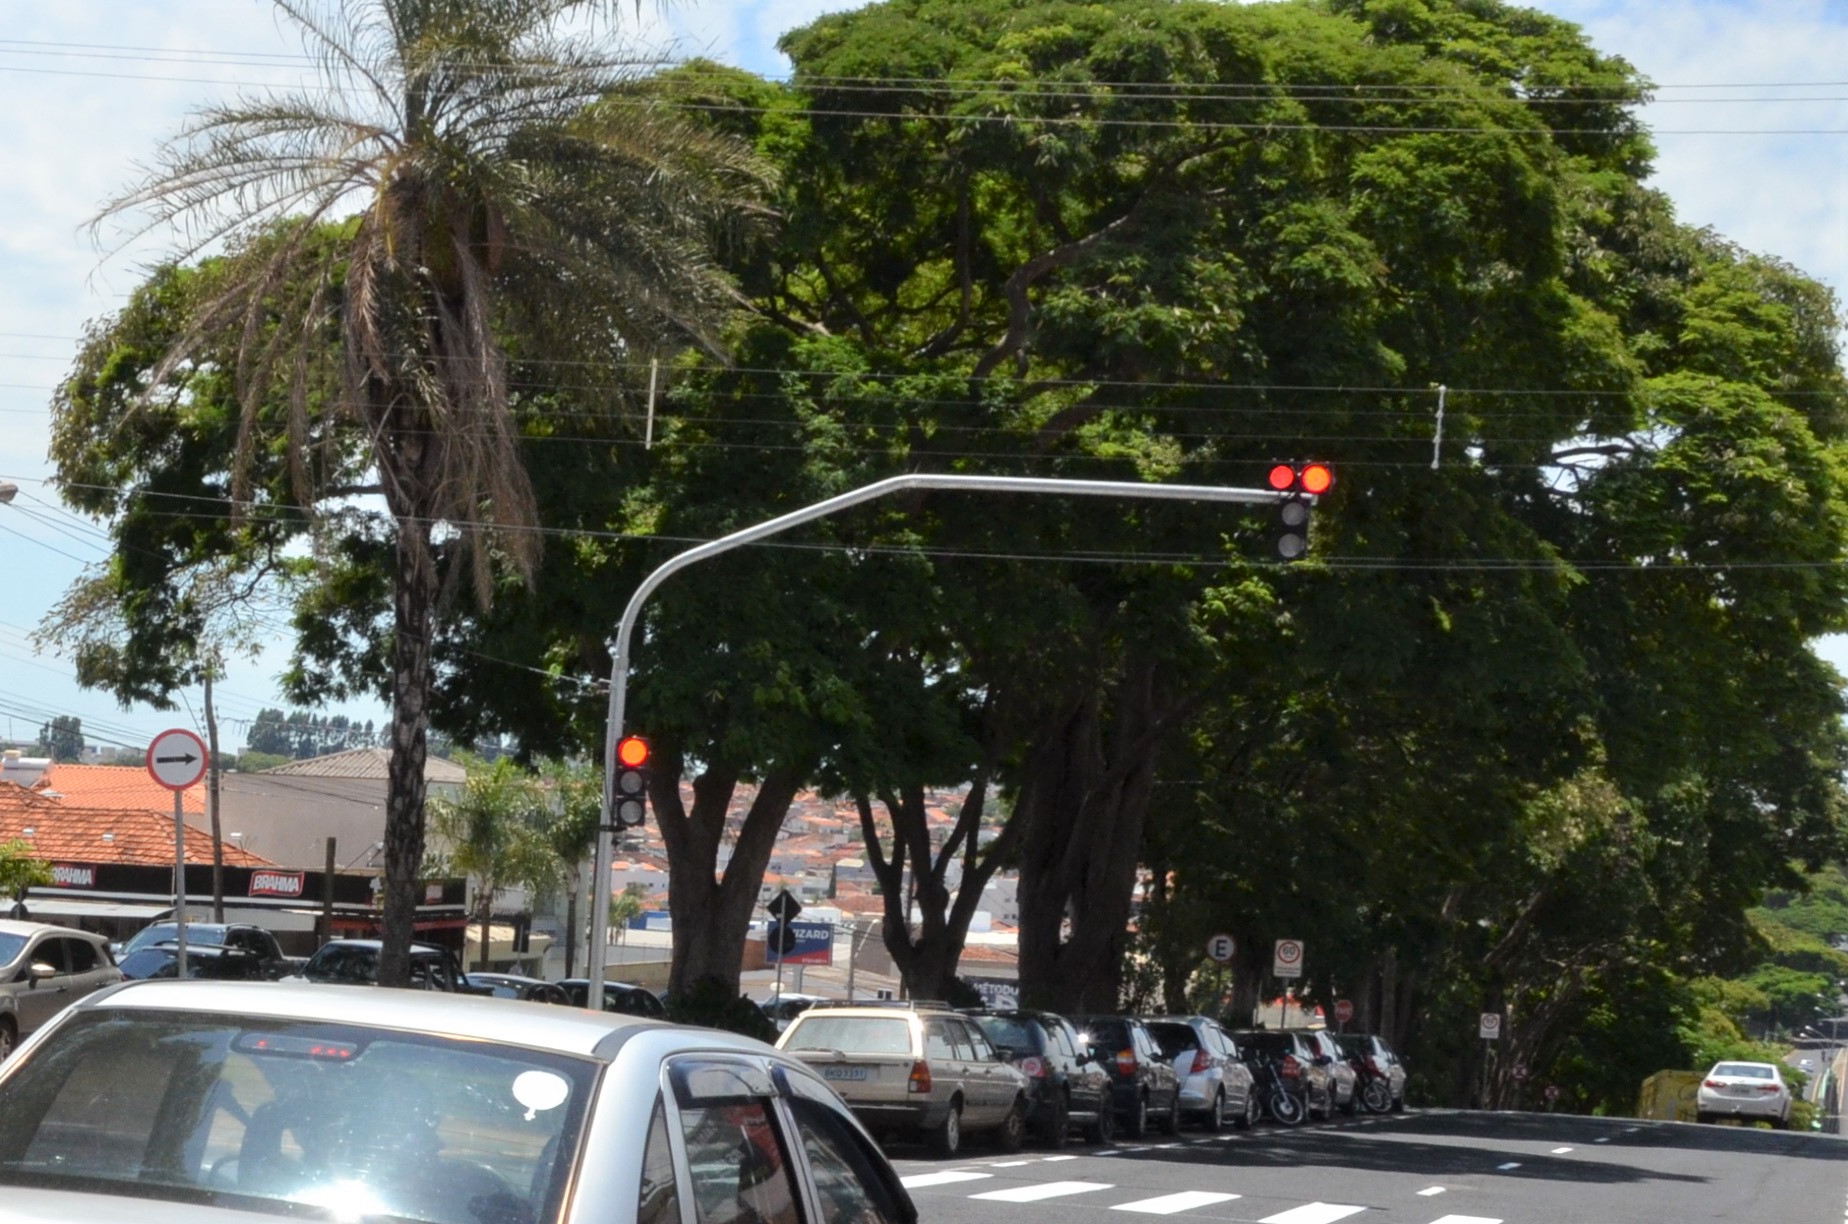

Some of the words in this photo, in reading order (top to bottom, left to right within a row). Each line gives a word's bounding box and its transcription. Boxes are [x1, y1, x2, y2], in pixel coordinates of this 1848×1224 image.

[253, 875, 300, 893] BRAHMA
[793, 928, 829, 940] IZARD
[1215, 939, 1228, 957] E
